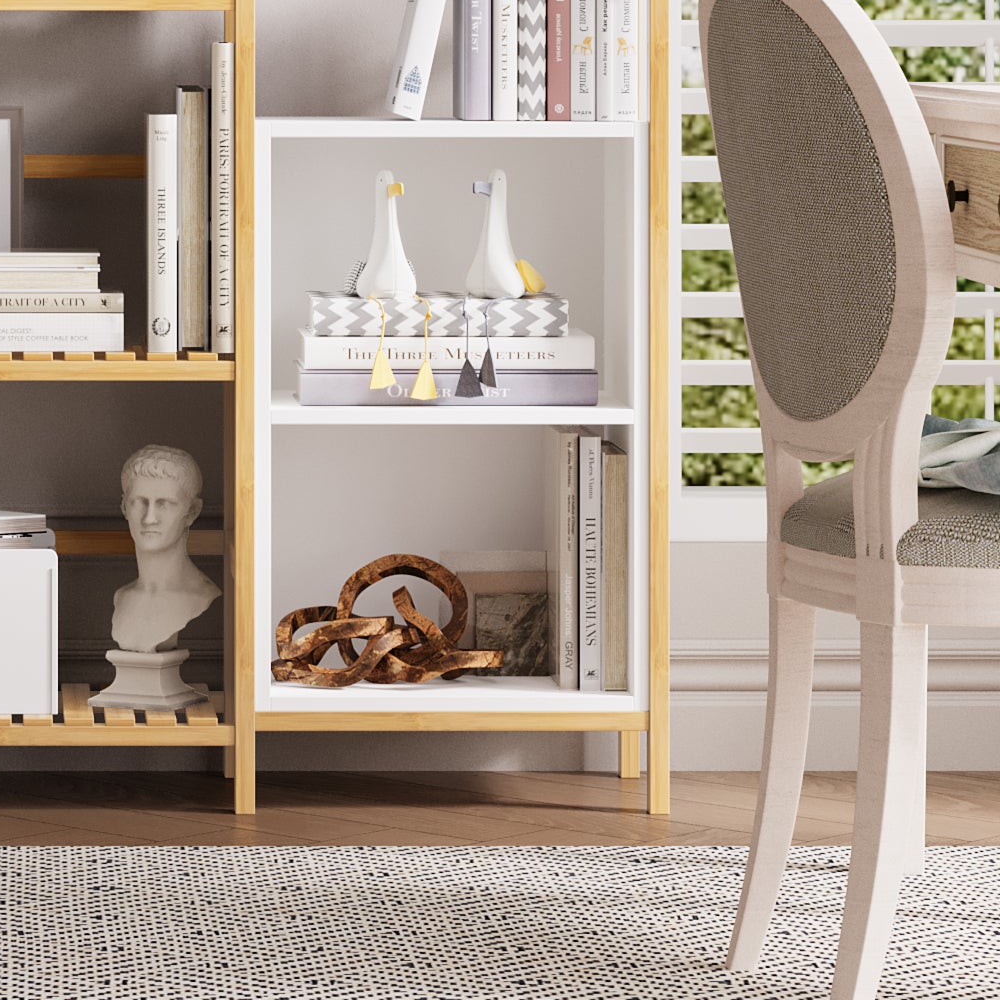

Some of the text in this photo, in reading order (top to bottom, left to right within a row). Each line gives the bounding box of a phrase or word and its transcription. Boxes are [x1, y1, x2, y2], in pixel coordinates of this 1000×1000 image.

[471, 11, 483, 53] TWIST
[620, 62, 632, 94] Каплан
[219, 173, 230, 238] PORTRAIT
[157, 187, 167, 276] THREE ISLANDS
[34, 297, 48, 307] OF
[62, 297, 87, 307] CITY
[219, 277, 230, 309] CITY
[343, 348, 556, 361] THE THREE MUSETEERS
[585, 518, 597, 647] HAUTE BOHEMIANS
[564, 573, 574, 670] Jasper GRAY
